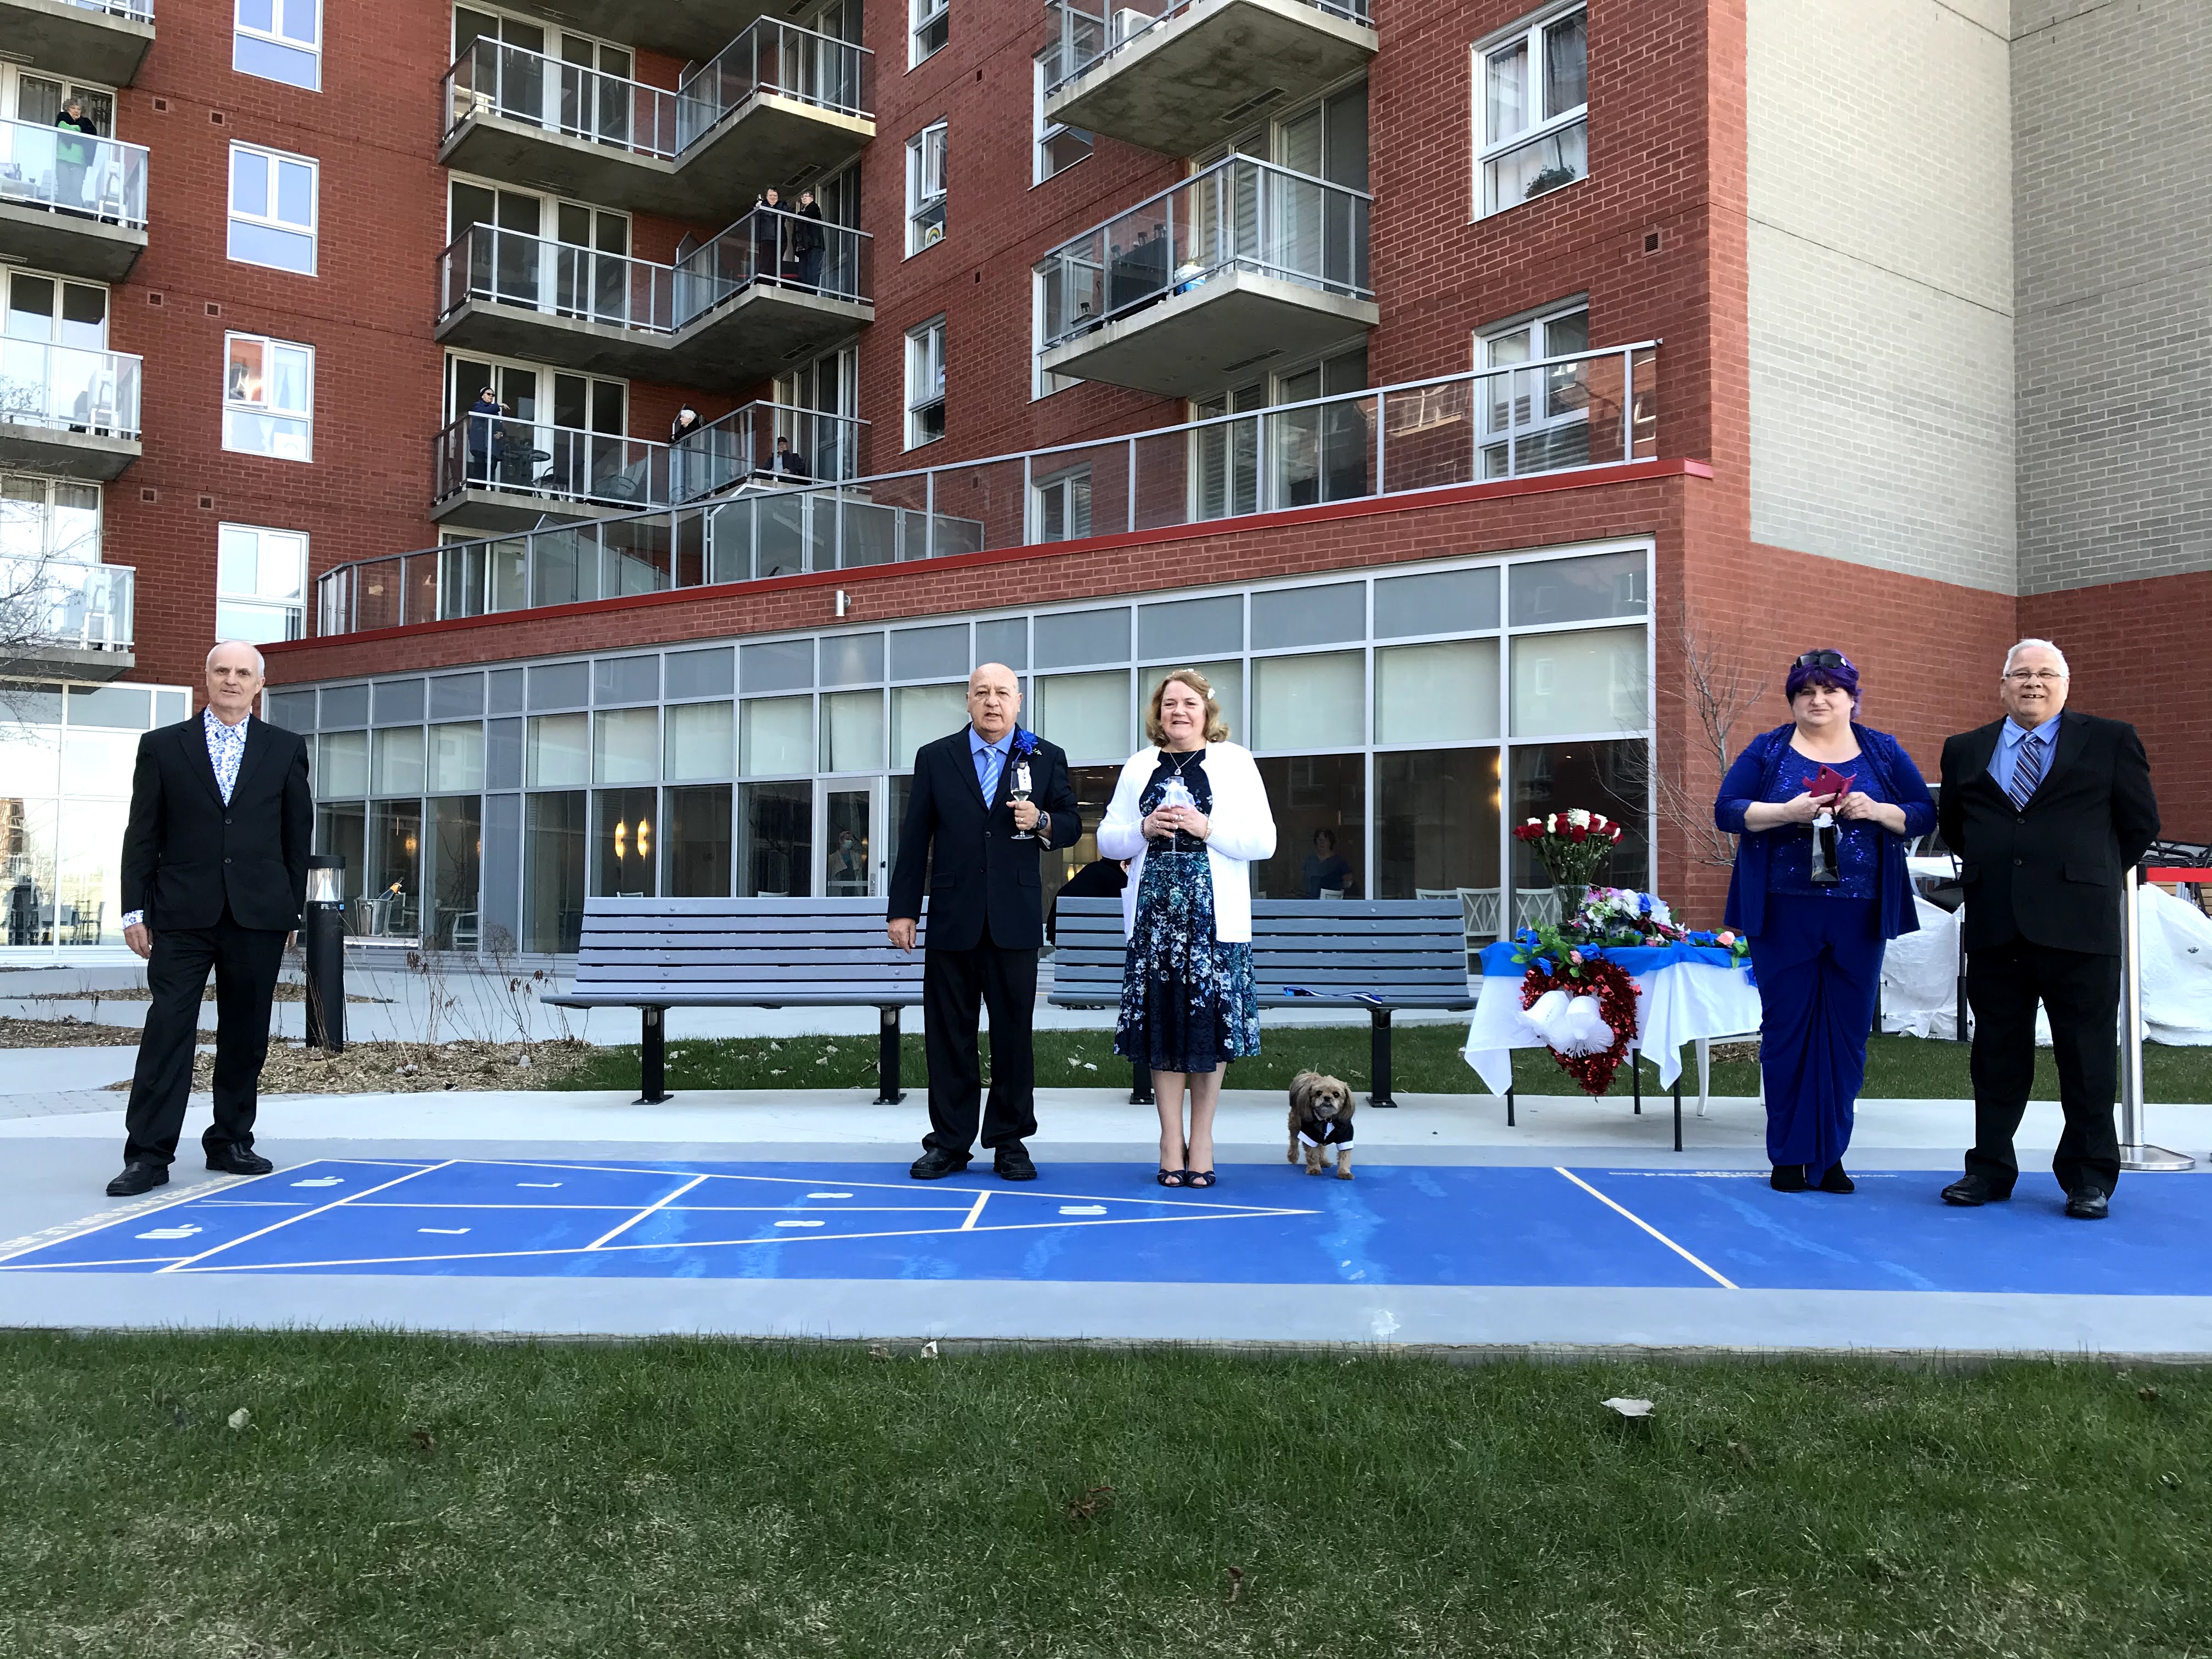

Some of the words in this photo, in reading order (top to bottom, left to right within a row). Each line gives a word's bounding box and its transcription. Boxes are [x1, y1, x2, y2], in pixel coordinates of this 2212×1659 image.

[111, 1200, 165, 1212] PAS
[1058, 1204, 1108, 1216] 10
[64, 1212, 125, 1226] SUR
[773, 1220, 826, 1228] 8
[31, 1226, 80, 1235] LE
